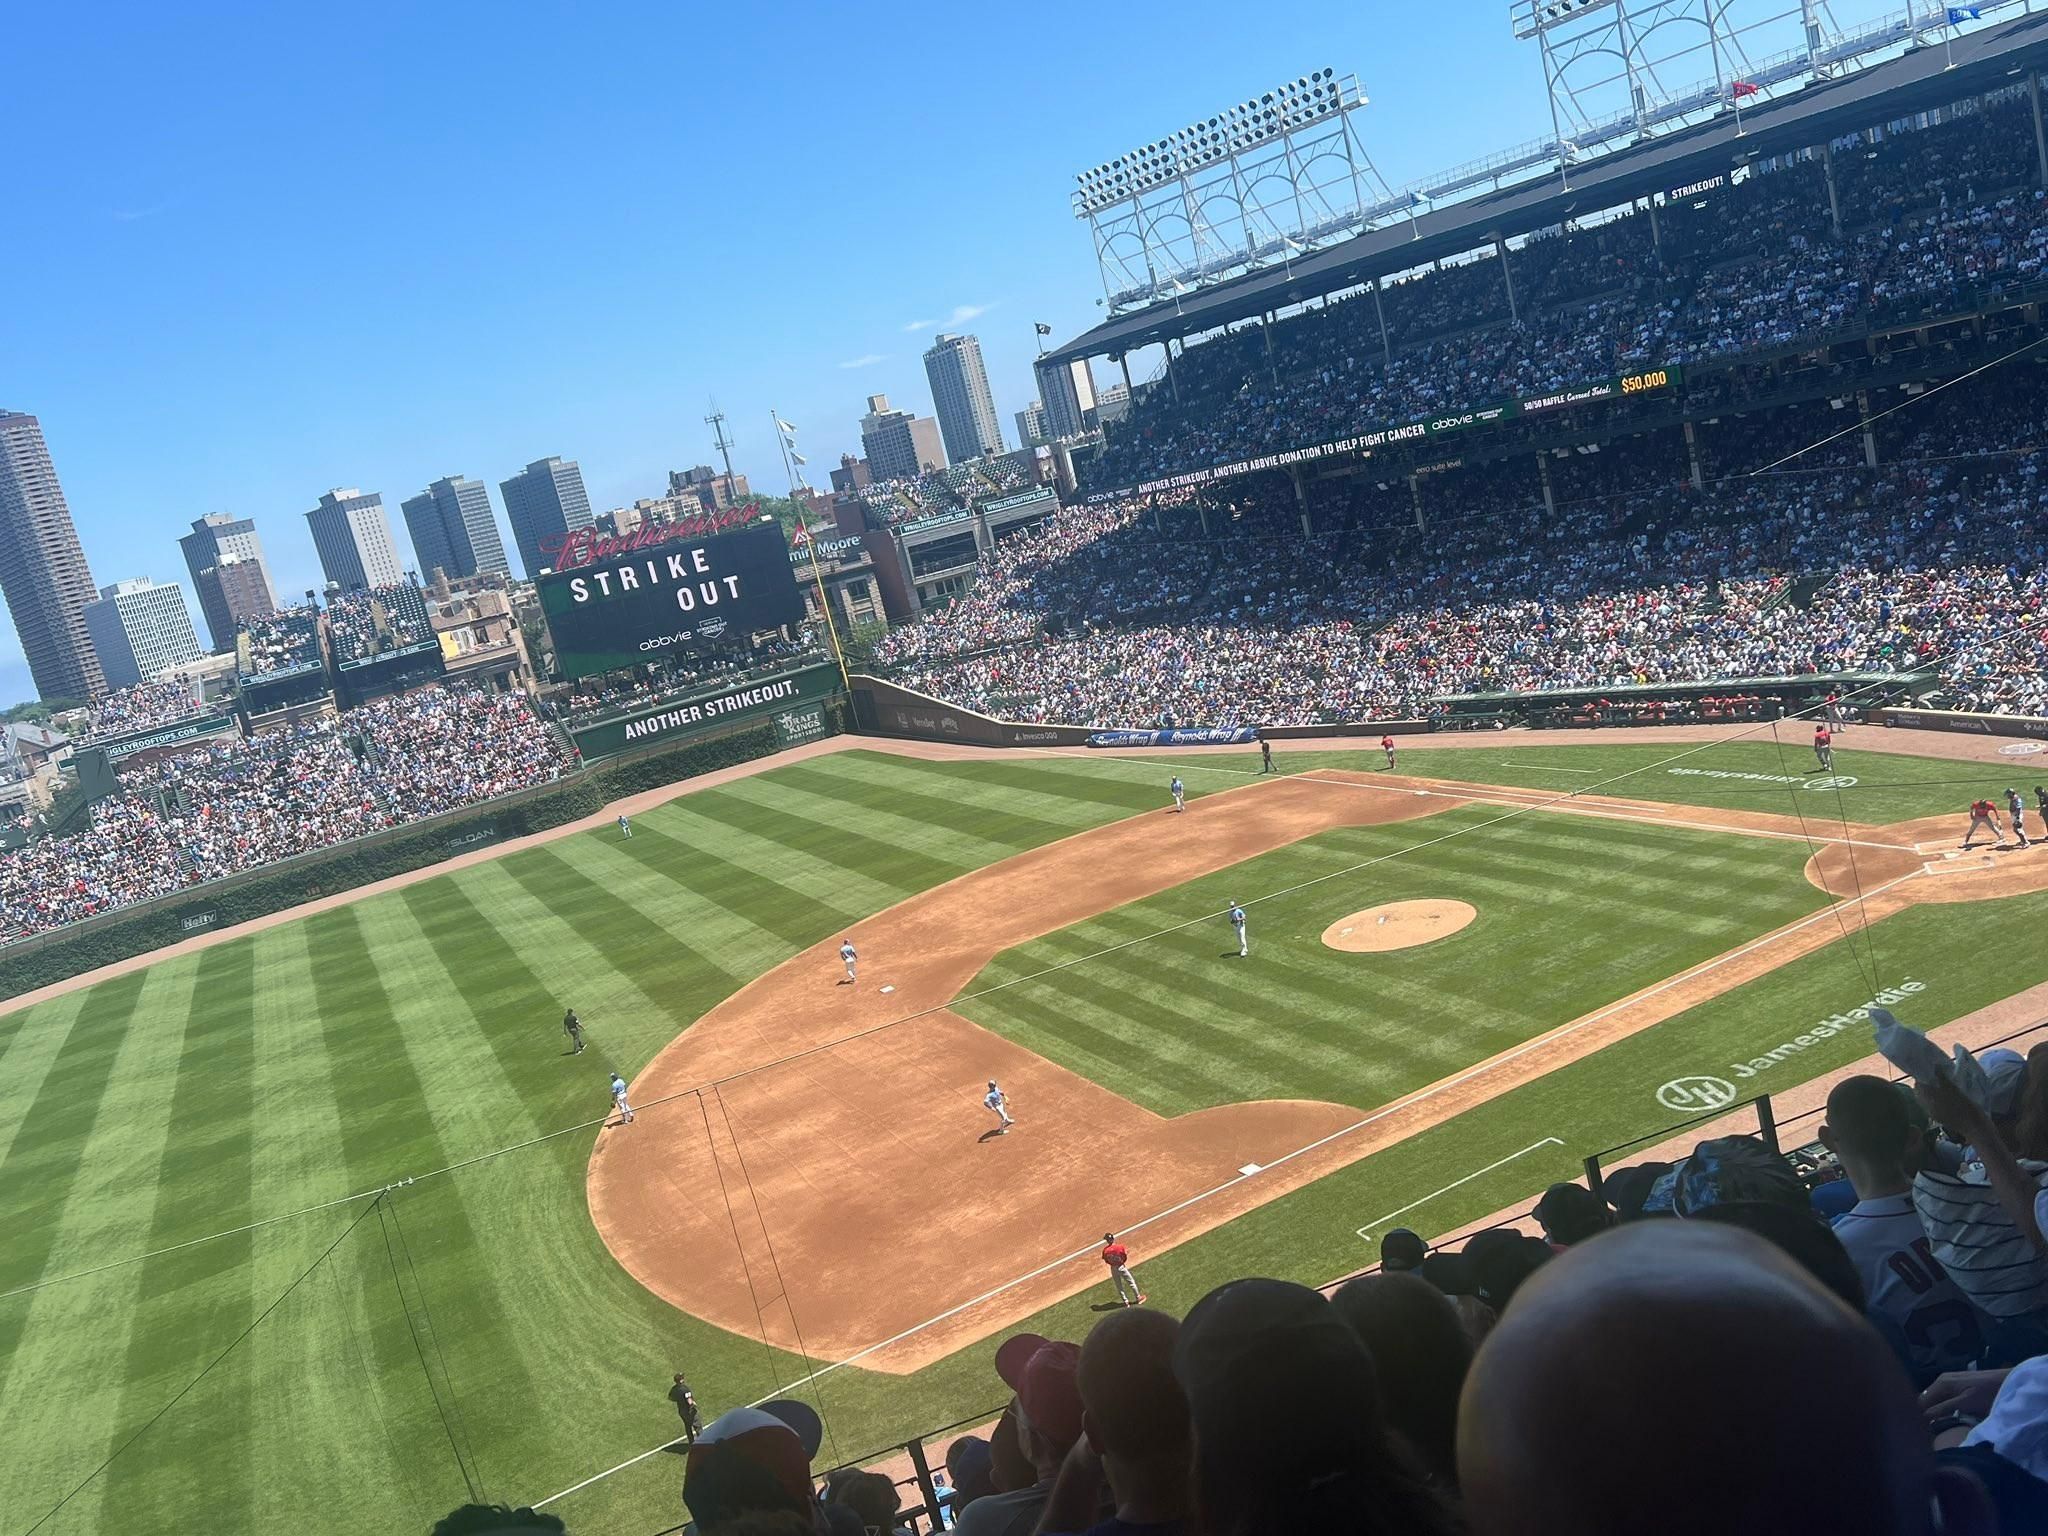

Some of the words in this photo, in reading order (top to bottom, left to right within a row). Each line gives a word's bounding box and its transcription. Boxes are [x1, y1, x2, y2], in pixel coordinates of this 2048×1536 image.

[1671, 175, 1724, 200] STRIKEOUT!
[1524, 399, 1542, 411] 50/50
[1542, 394, 1566, 409] RAFFLE
[1566, 389, 1590, 402] Current
[1621, 371, 1667, 394] $50,000
[1431, 414, 1473, 430] abbvie
[1138, 479, 1170, 494] ANOTHER
[1170, 471, 1213, 488] STRIKEOUT,
[1214, 462, 1249, 479] ANOTHER
[1250, 454, 1279, 471] ABBVIE
[1279, 447, 1321, 465] DONATION
[1321, 443, 1335, 455] TO
[1335, 438, 1358, 453] HELP
[1359, 432, 1386, 448] FIGHT
[1387, 423, 1426, 443] CANCER
[986, 489, 1050, 512] WRIGLEYROOFTOPS.COM
[903, 511, 968, 533] WRIGLEYROOFTOPS.COM
[816, 536, 860, 555] Moore
[570, 548, 710, 603] STRIKE
[676, 575, 739, 612] OUT
[639, 629, 693, 651] abbvie
[625, 704, 703, 740] ANOTHER
[705, 679, 800, 717] STRIKEOUT,
[783, 711, 819, 729] DRAFT
[789, 719, 821, 734] KINGS
[1171, 729, 1209, 743] Reynolds
[1208, 728, 1232, 741] Wrap
[1950, 720, 1982, 729] American
[108, 727, 198, 755] IGLEYROOFTOPS.COM
[1022, 732, 1045, 740] Invesco
[1128, 733, 1148, 745] Wrap
[449, 828, 495, 848] SLOAN
[183, 912, 215, 928] Hefty
[1729, 977, 1928, 1079] JamesHardie
